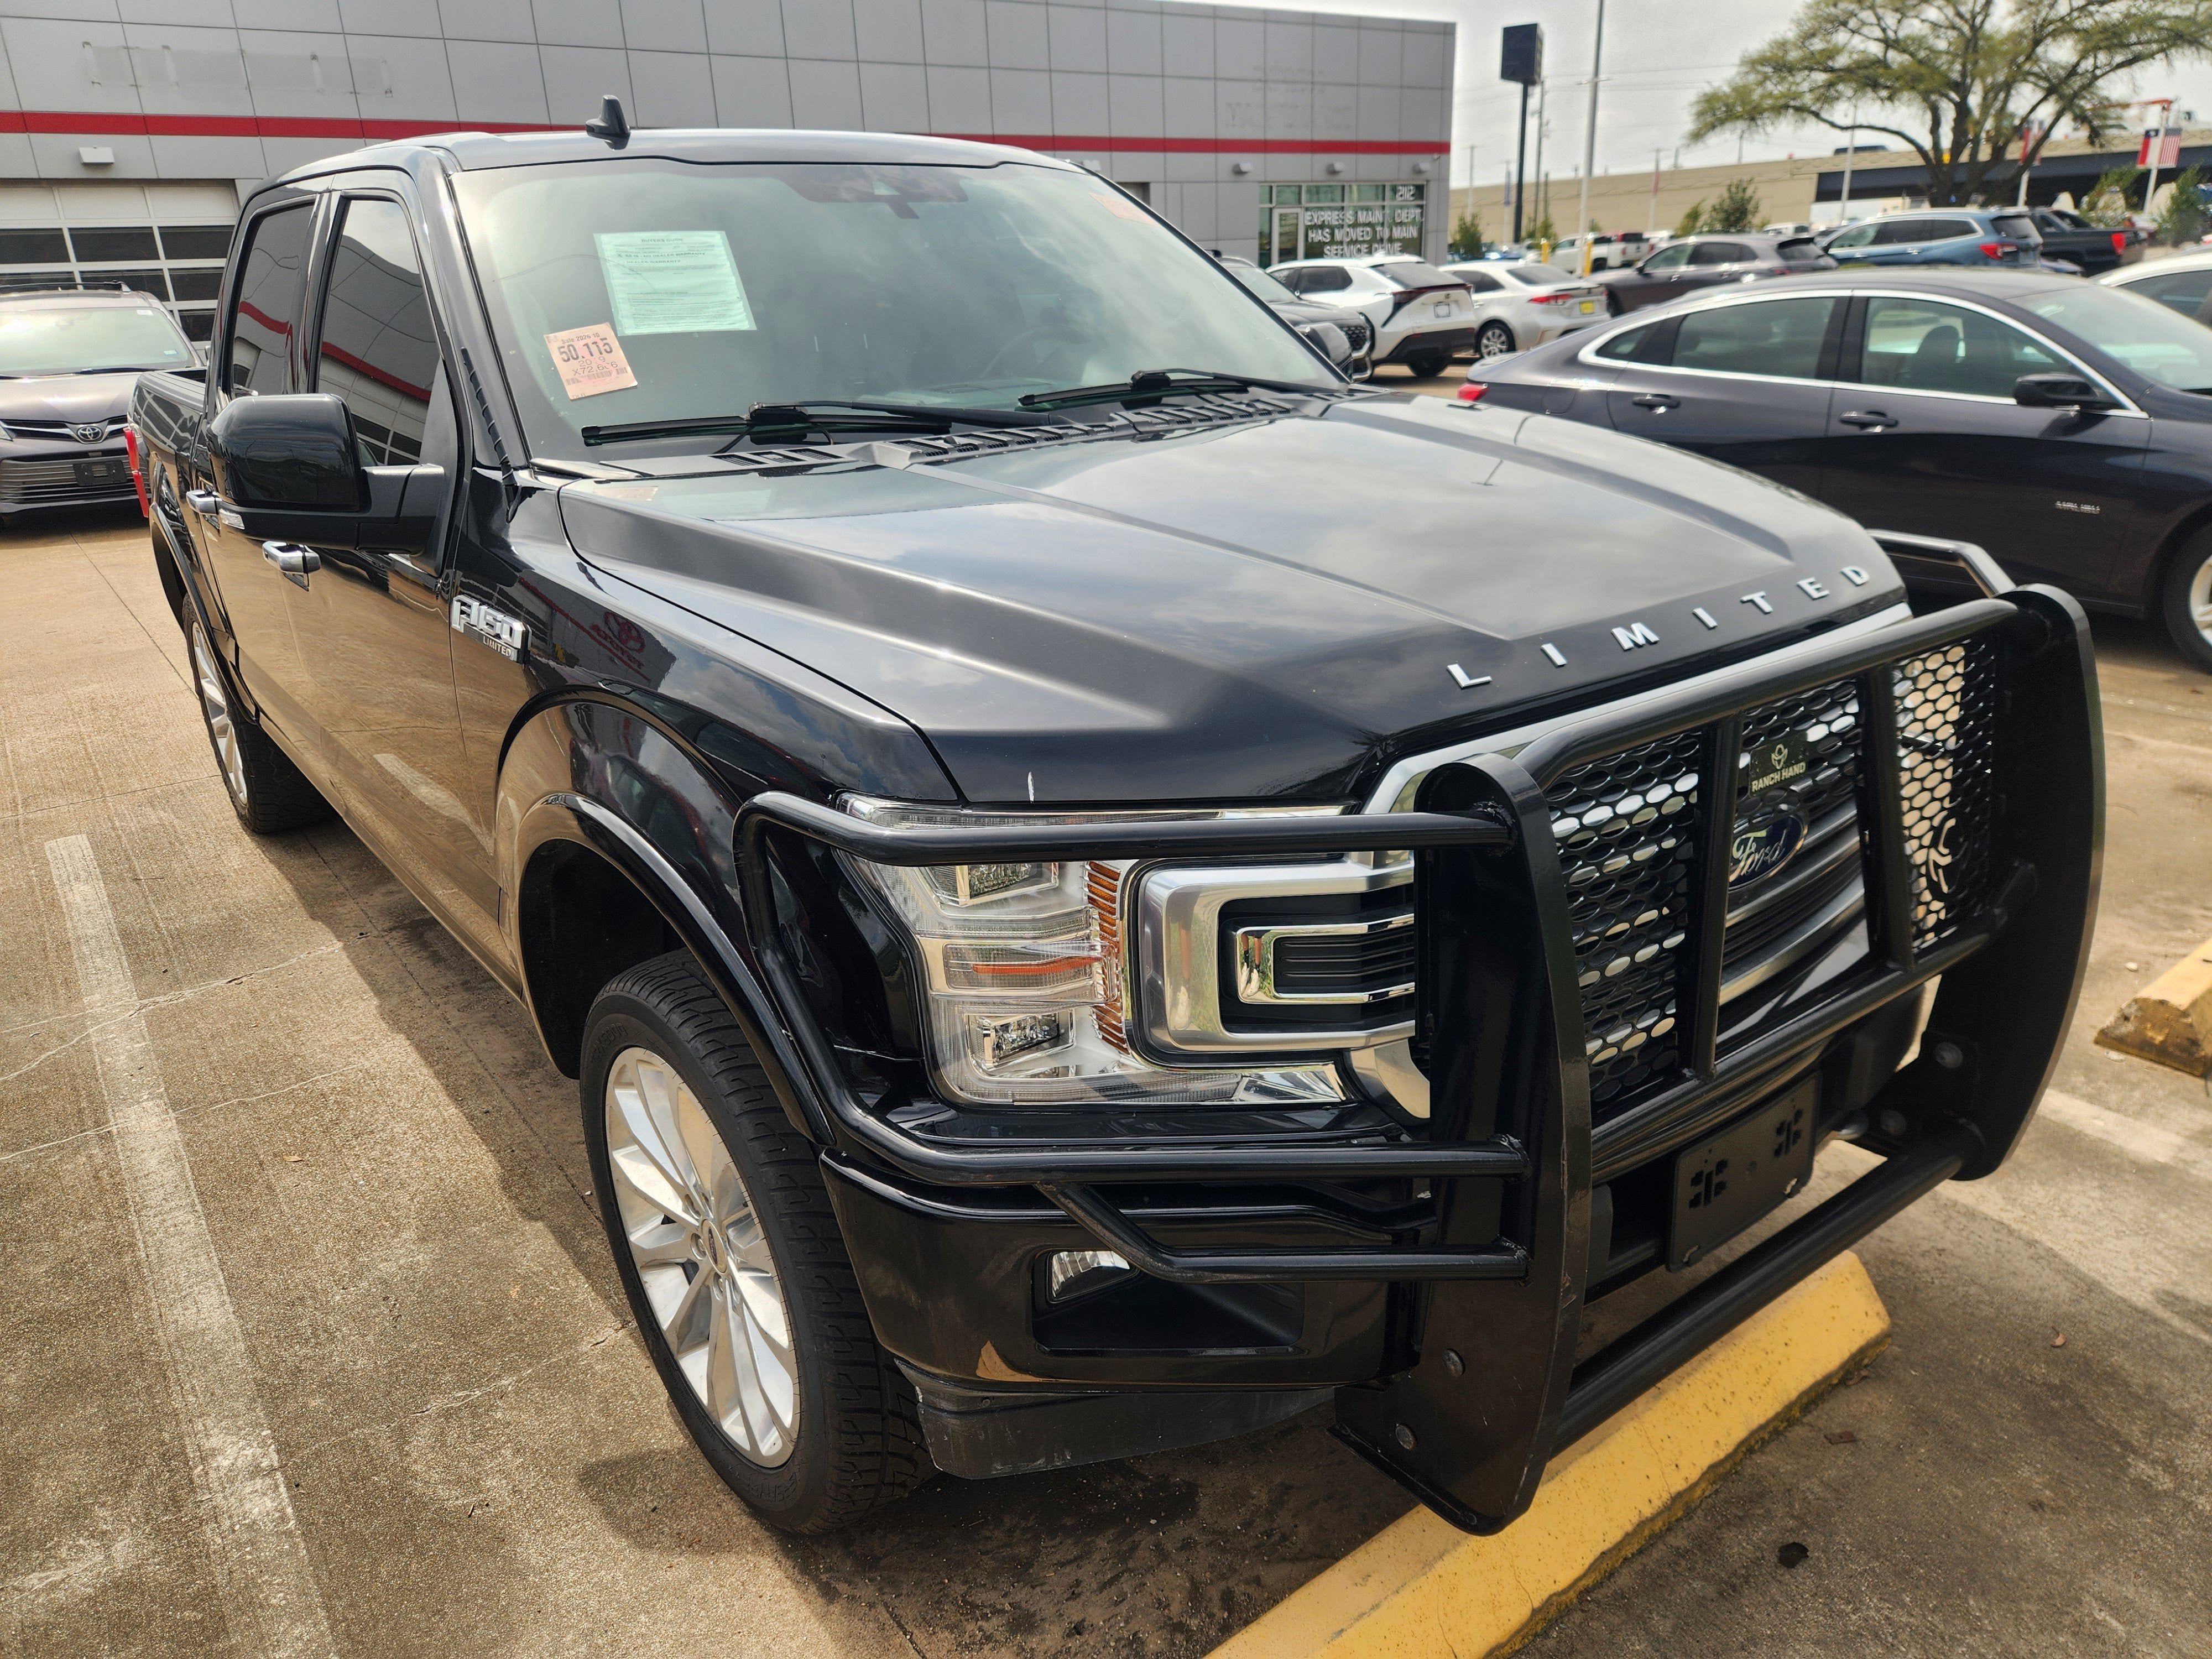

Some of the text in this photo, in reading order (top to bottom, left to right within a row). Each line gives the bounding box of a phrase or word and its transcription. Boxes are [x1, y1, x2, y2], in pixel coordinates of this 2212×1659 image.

[1304, 208, 1354, 225] EXPRESS
[1395, 208, 1424, 223] DEPT.
[1308, 225, 1418, 242] HAS MOVED TO MAIN
[578, 356, 606, 367] 209
[1446, 565, 1871, 690] LIMITED
[483, 635, 512, 658] LIMITED
[1751, 761, 1806, 792] RANCH HAND
[1729, 829, 1786, 883] Ford
